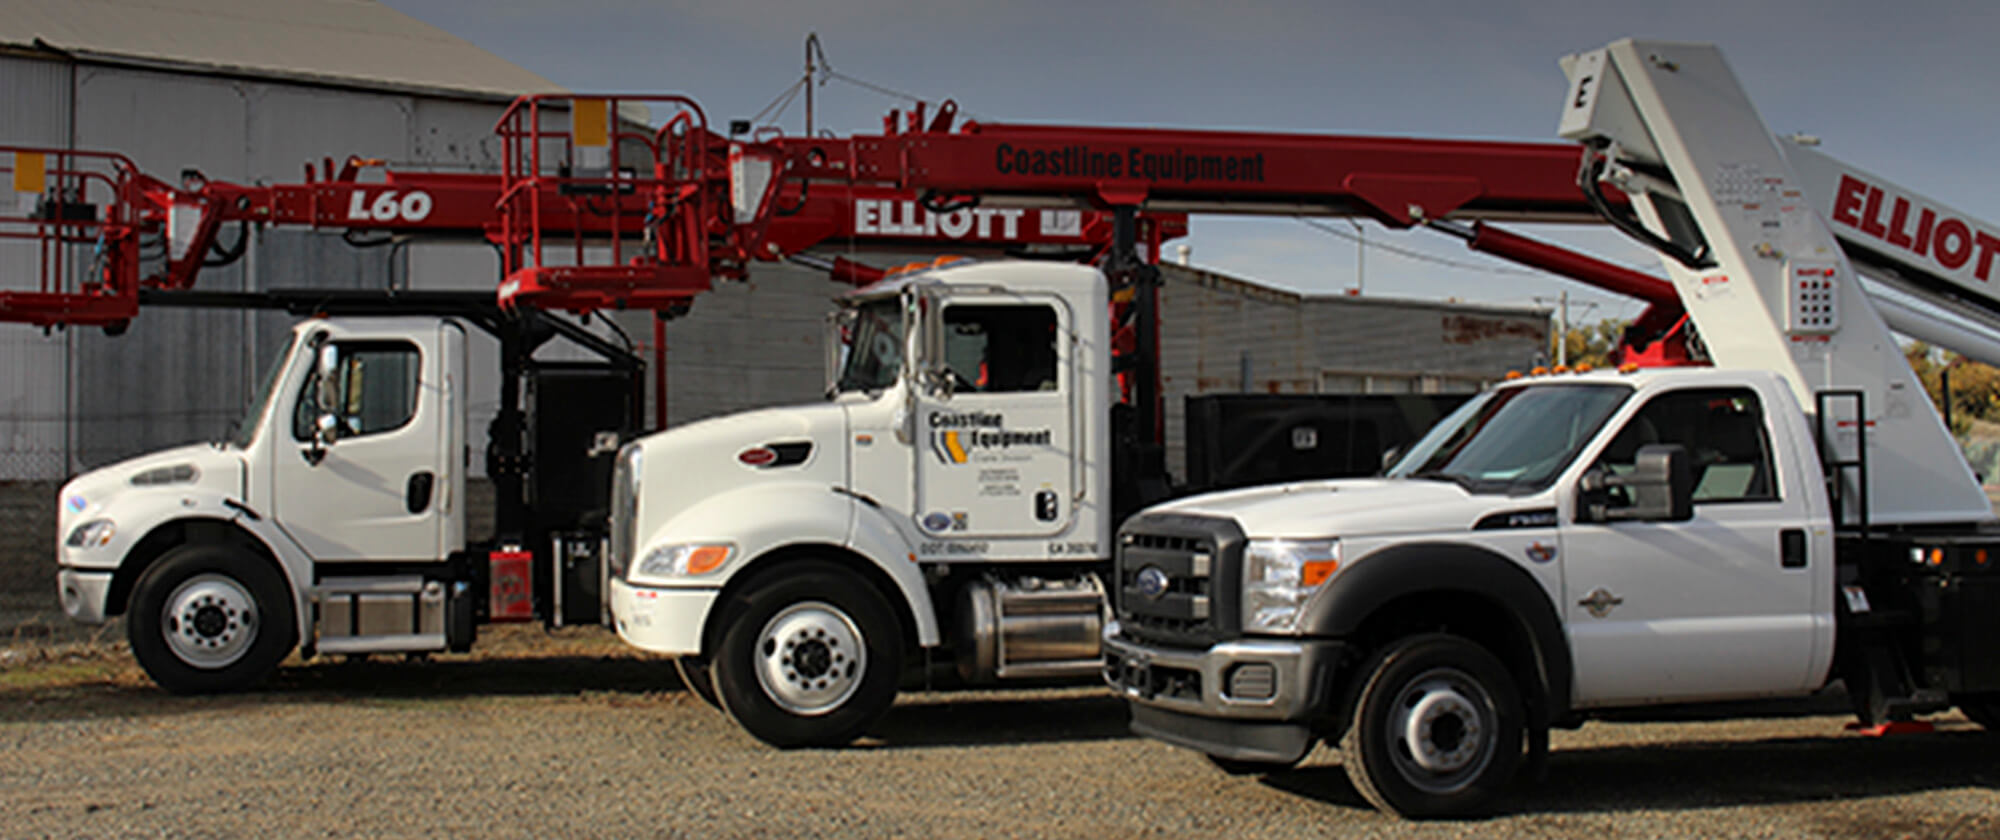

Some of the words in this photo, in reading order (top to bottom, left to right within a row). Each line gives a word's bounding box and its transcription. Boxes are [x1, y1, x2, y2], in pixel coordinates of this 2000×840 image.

[1574, 75, 1593, 109] E
[995, 143, 1123, 178] Coastline
[1128, 148, 1265, 184] Equipment
[347, 190, 432, 222] L60
[855, 199, 1024, 239] ELLIOTT
[928, 410, 1003, 429] Coastline
[972, 429, 1050, 448] Equipment
